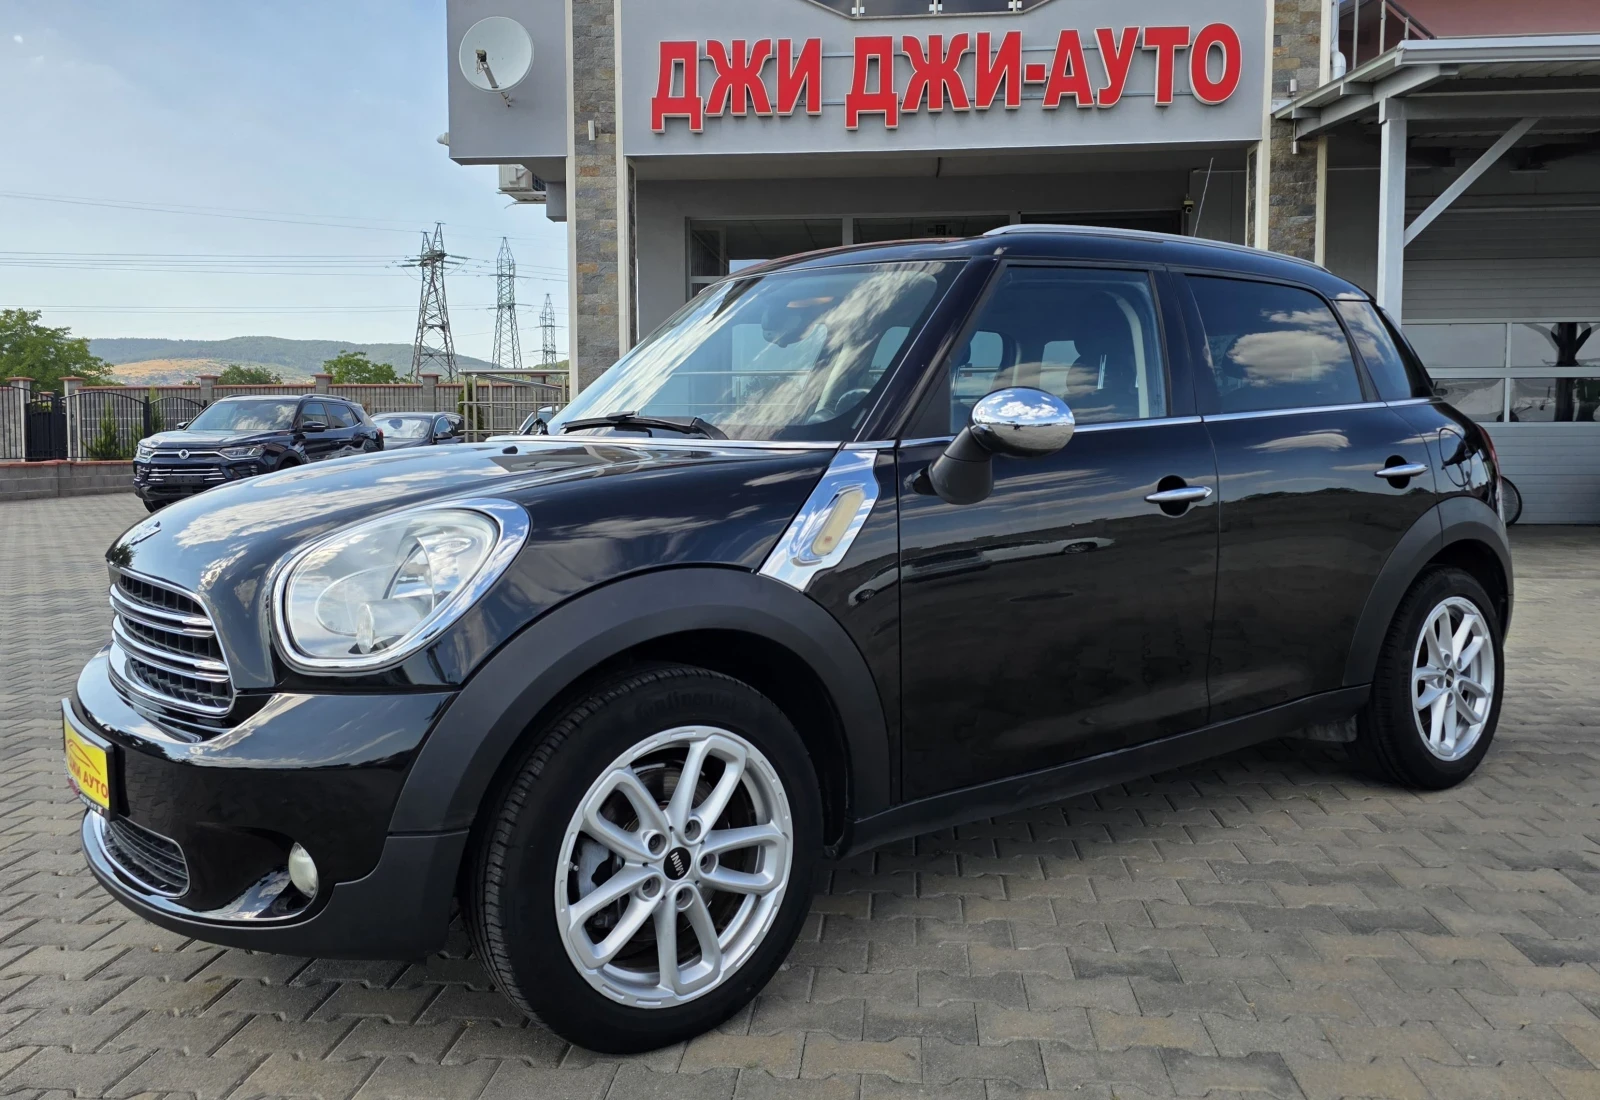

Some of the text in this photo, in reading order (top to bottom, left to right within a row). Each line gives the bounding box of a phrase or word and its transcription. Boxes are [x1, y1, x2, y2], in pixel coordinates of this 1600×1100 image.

[651, 22, 1242, 133] ДЖИ ДЖИ-АУТО
[83, 770, 109, 799] АУТО
[670, 851, 685, 877] MINI
